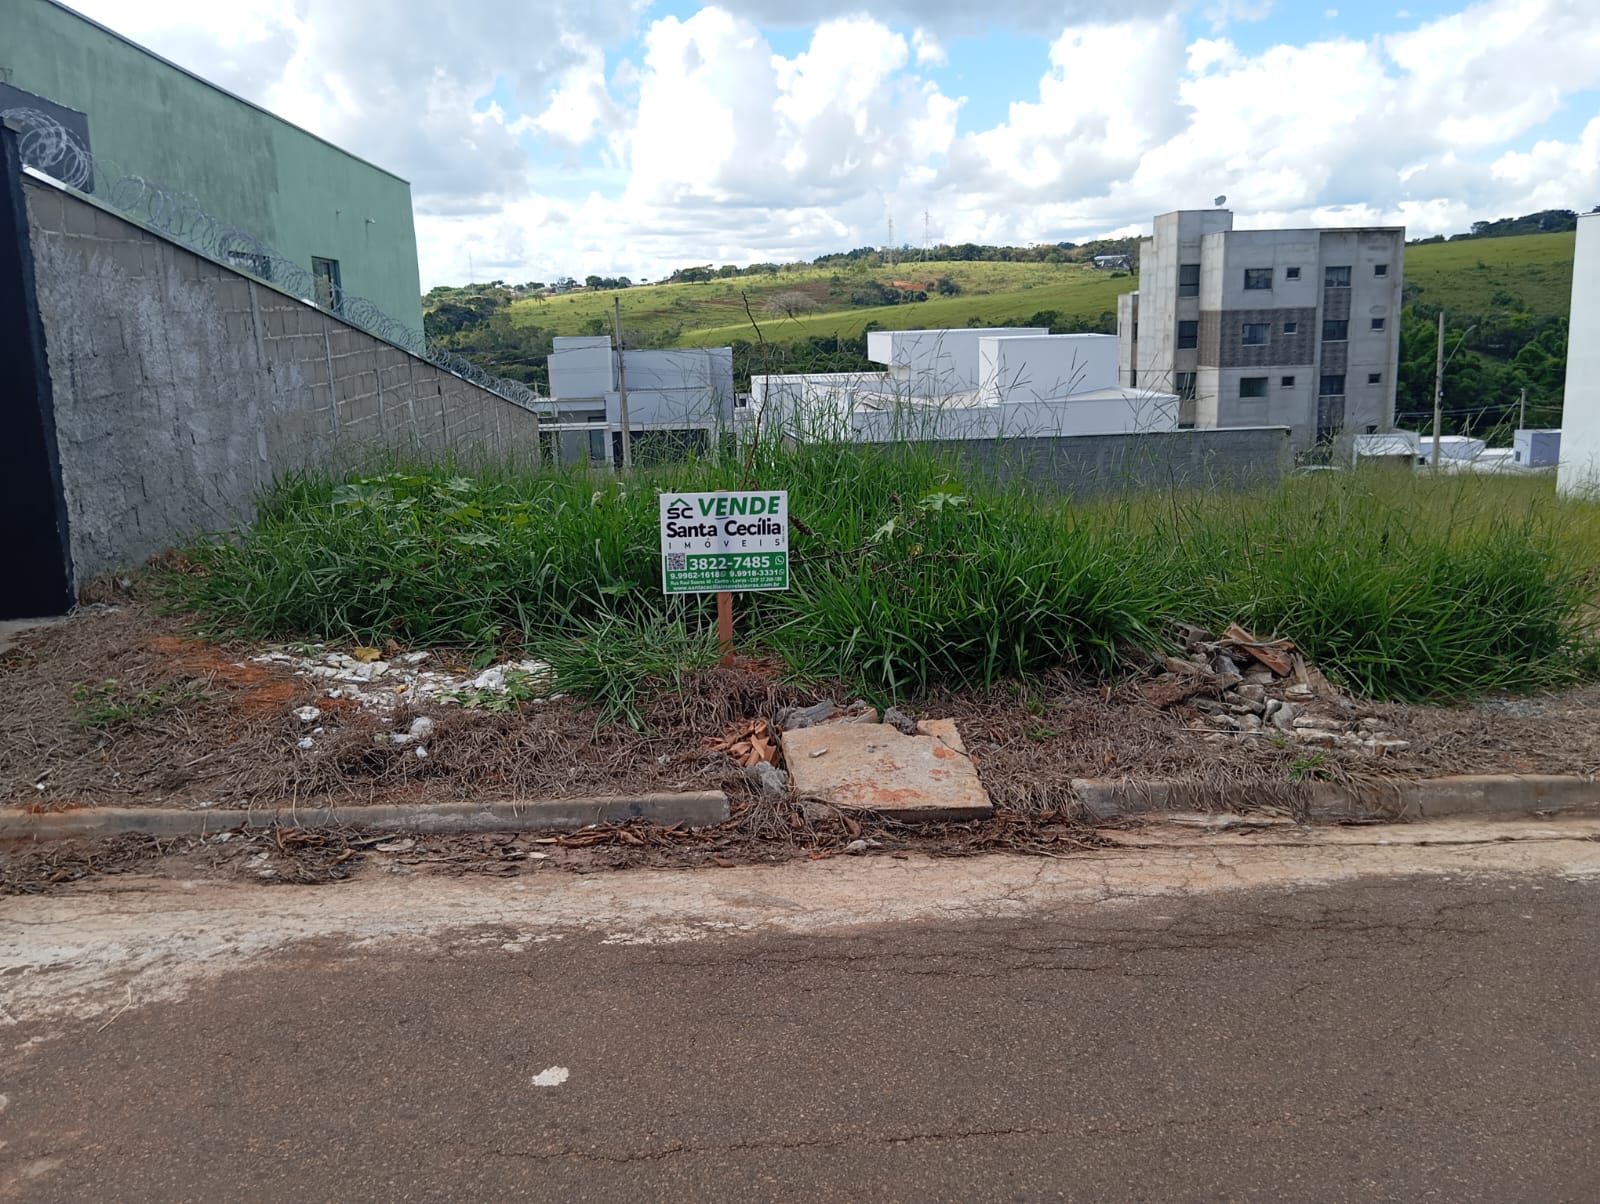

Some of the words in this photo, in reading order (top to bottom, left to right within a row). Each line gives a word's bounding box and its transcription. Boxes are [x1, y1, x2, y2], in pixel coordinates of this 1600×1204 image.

[698, 496, 781, 517] VENDE
[666, 522, 717, 538] Santa
[724, 517, 781, 536] Cecília
[689, 556, 770, 570] 3822-7485
